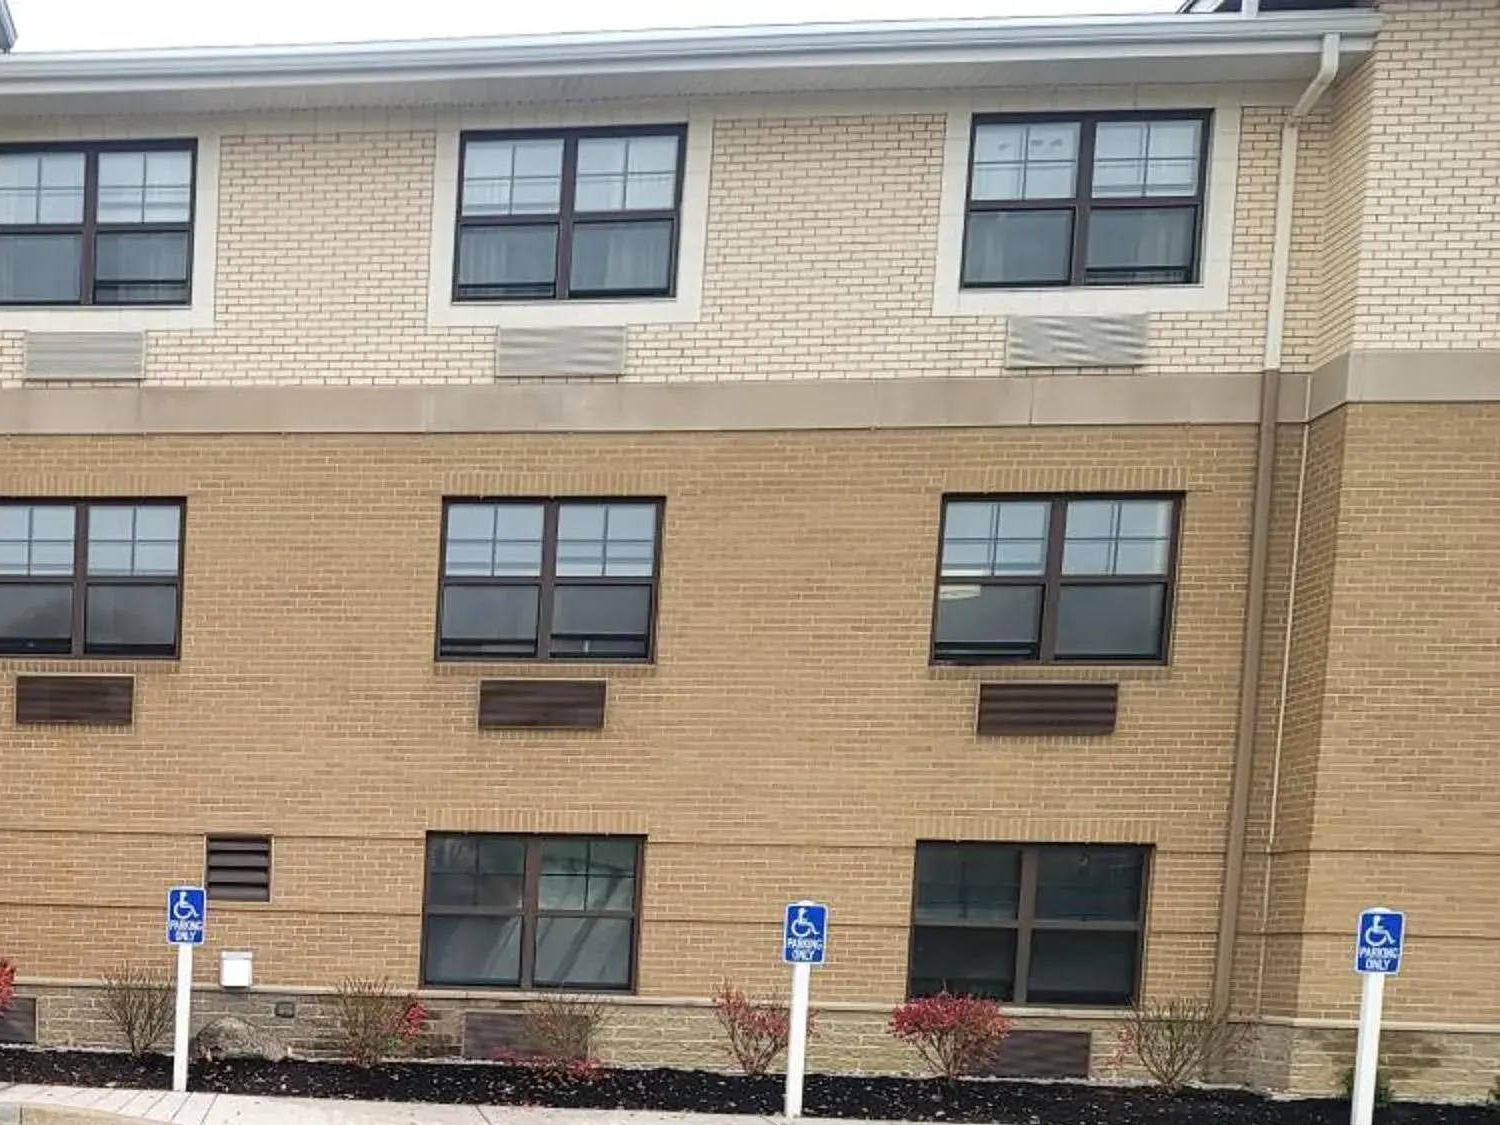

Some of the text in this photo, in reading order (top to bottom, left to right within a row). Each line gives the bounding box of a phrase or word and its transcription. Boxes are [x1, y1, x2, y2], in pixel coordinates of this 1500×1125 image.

[169, 920, 204, 930] PARKING
[787, 938, 823, 950] PARKING
[791, 949, 815, 961] ONLY
[1359, 946, 1398, 959] PARKING
[1365, 959, 1391, 970] ONLY
